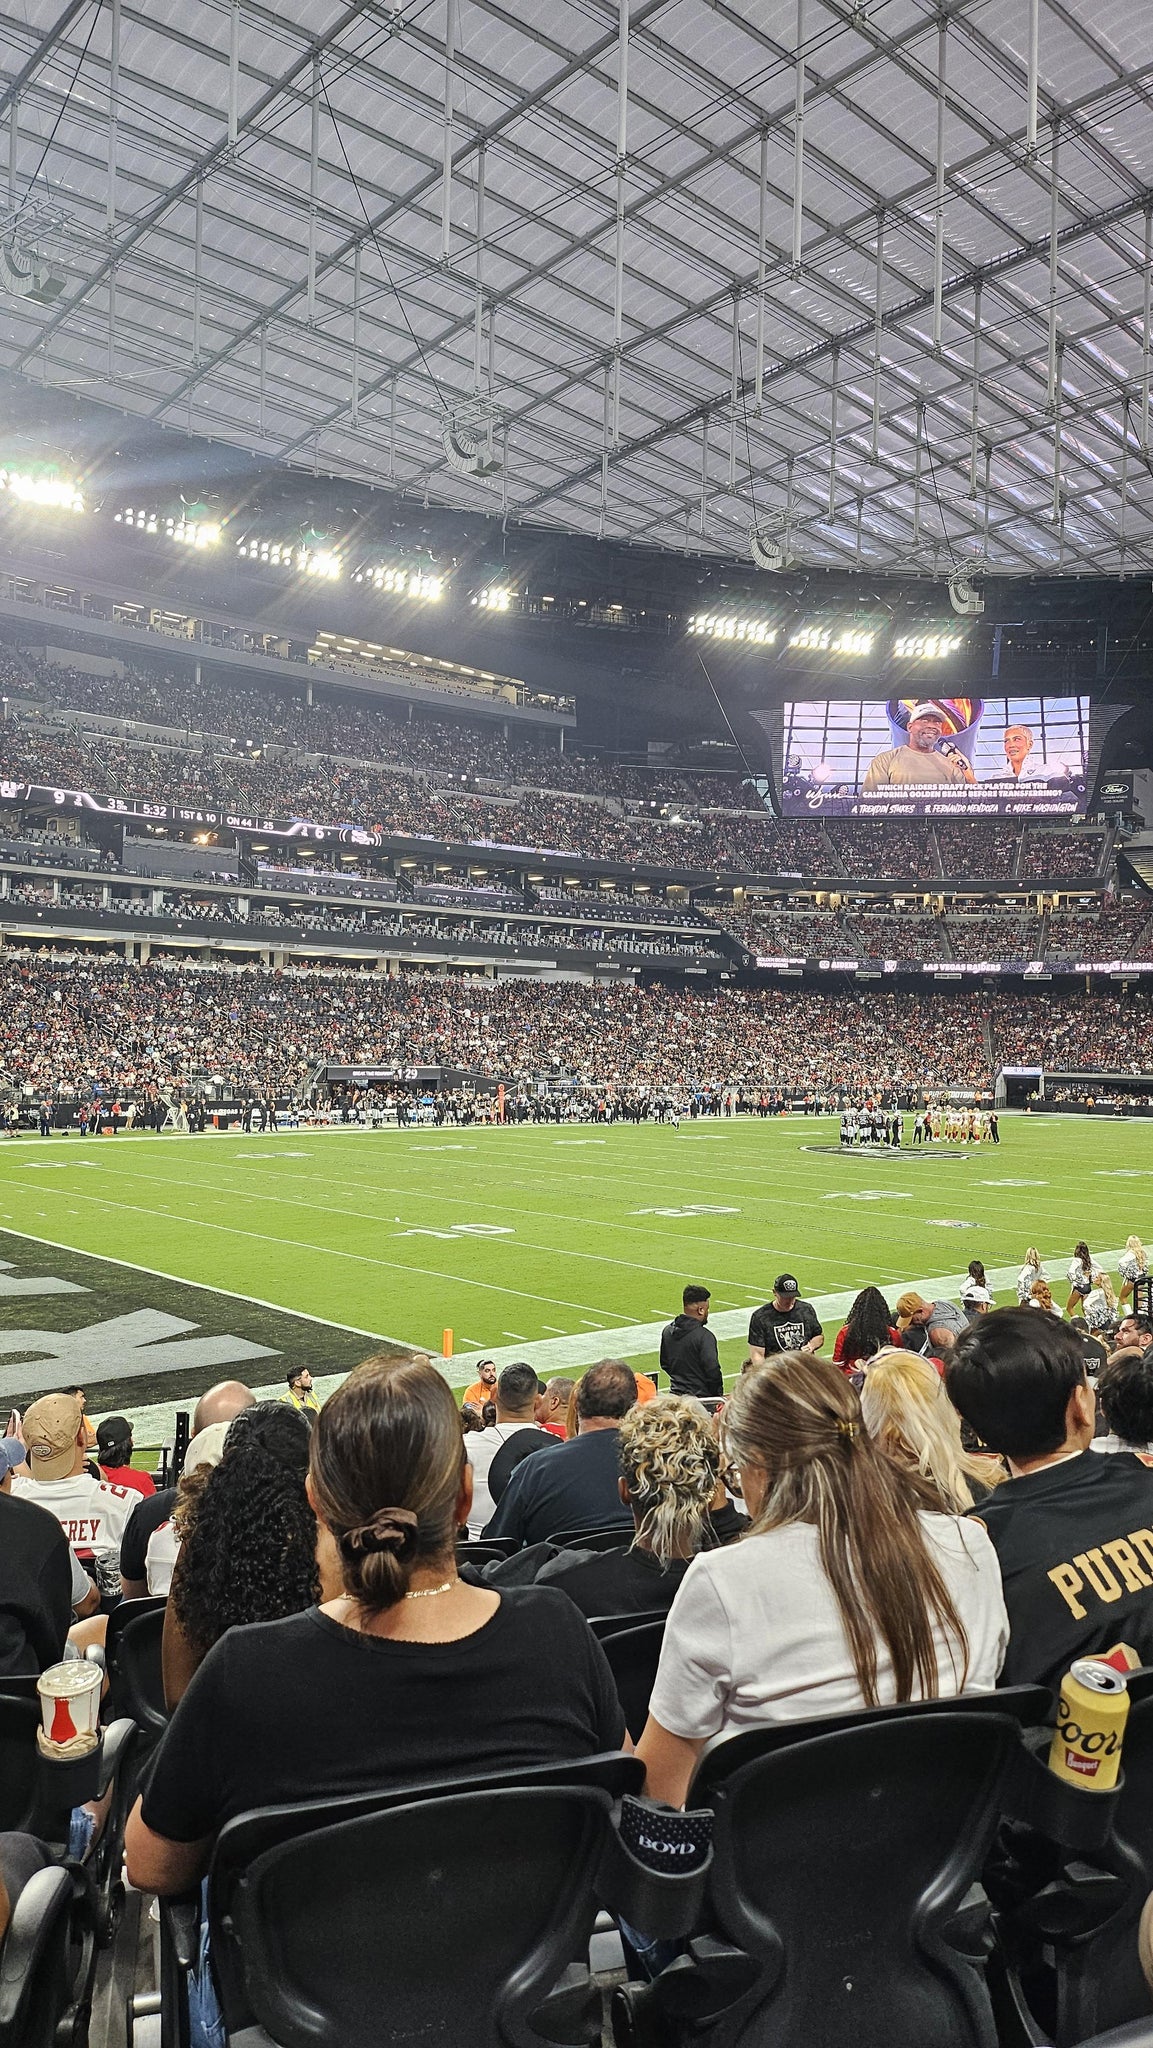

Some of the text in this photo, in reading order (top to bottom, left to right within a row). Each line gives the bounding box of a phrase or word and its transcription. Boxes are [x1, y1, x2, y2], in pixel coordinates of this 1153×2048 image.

[54, 790, 65, 804] 9
[107, 798, 115, 809] 3
[932, 803, 966, 814] FERNANDO
[967, 803, 999, 814] MENDOZA
[1013, 803, 1033, 813] MIKE
[1033, 802, 1078, 813] WASHINGTON
[143, 804, 167, 817] 5:32
[179, 810, 195, 820] 1ST
[206, 813, 216, 823] 10
[226, 816, 252, 827] ON 44
[263, 821, 274, 830] 25
[315, 827, 324, 839] 6
[923, 961, 1002, 971] LAS VEGAS RAIDERS
[1075, 963, 1092, 971] LAS
[1092, 962, 1120, 972] VEGAS
[1057, 1697, 1122, 1755] Coor
[639, 1834, 695, 1855] BOYD
